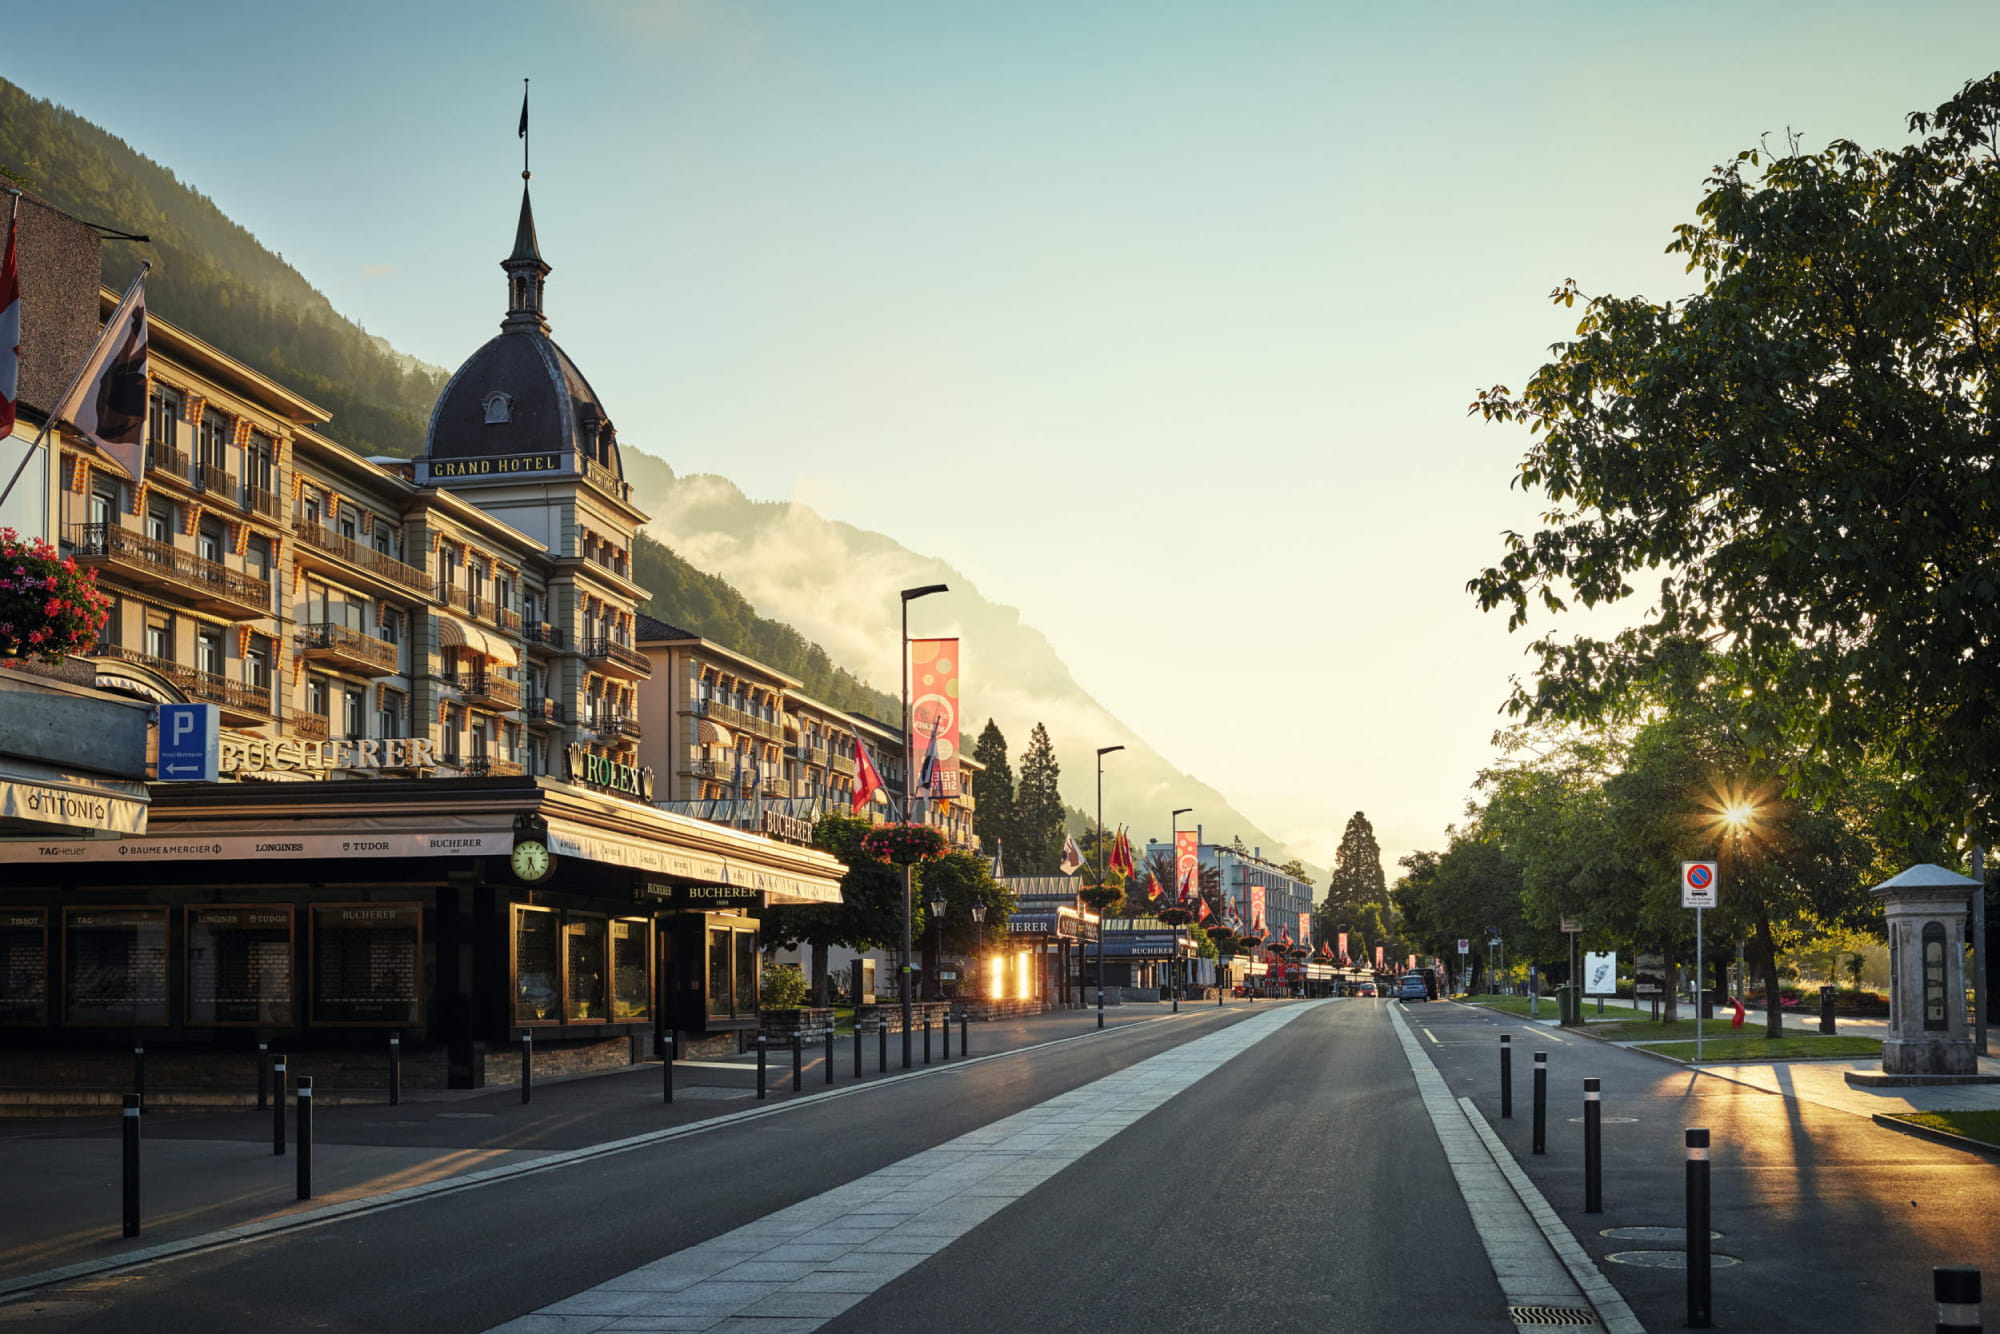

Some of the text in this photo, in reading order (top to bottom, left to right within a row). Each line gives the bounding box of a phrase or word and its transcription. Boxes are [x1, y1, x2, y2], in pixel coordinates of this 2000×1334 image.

[434, 455, 556, 477] GRAND HOTEL
[173, 711, 194, 746] P
[218, 737, 437, 773] BUCHERER
[586, 753, 642, 796] ROLEX
[41, 794, 93, 820] TITONI
[767, 810, 813, 843] BUCHERER
[255, 842, 304, 852] LONGINES
[353, 842, 390, 851] TUDOR
[429, 839, 482, 848] BUCHERER
[647, 882, 673, 897] BUCHERER
[688, 887, 758, 899] BUCHERER
[257, 915, 288, 923] TUDOR
[342, 910, 397, 919] BUCHERER
[10, 917, 40, 925] TISSOT
[1131, 947, 1174, 955] BUCHERER
